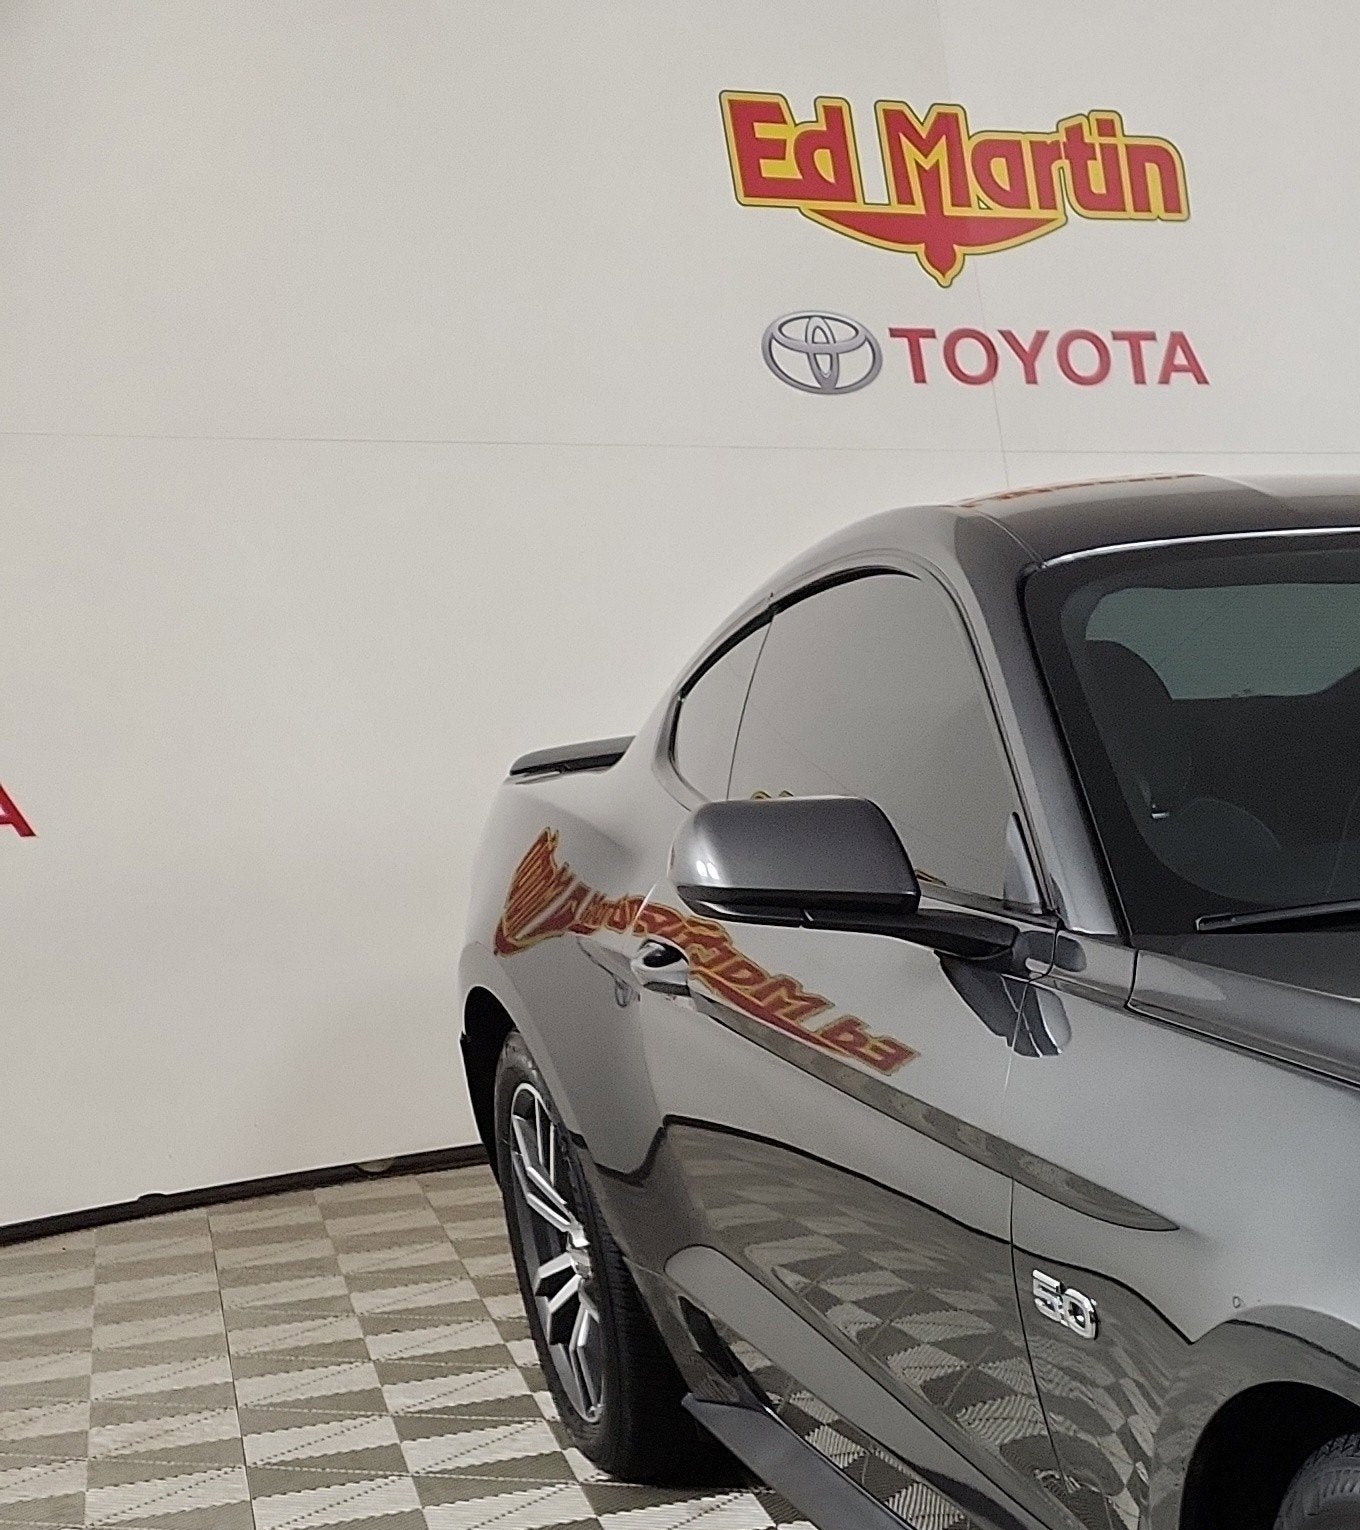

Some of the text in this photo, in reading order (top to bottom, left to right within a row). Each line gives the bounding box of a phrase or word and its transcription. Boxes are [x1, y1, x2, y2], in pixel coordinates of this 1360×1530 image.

[720, 91, 1190, 220] Ed Martin
[887, 326, 1210, 386] TOYOTA
